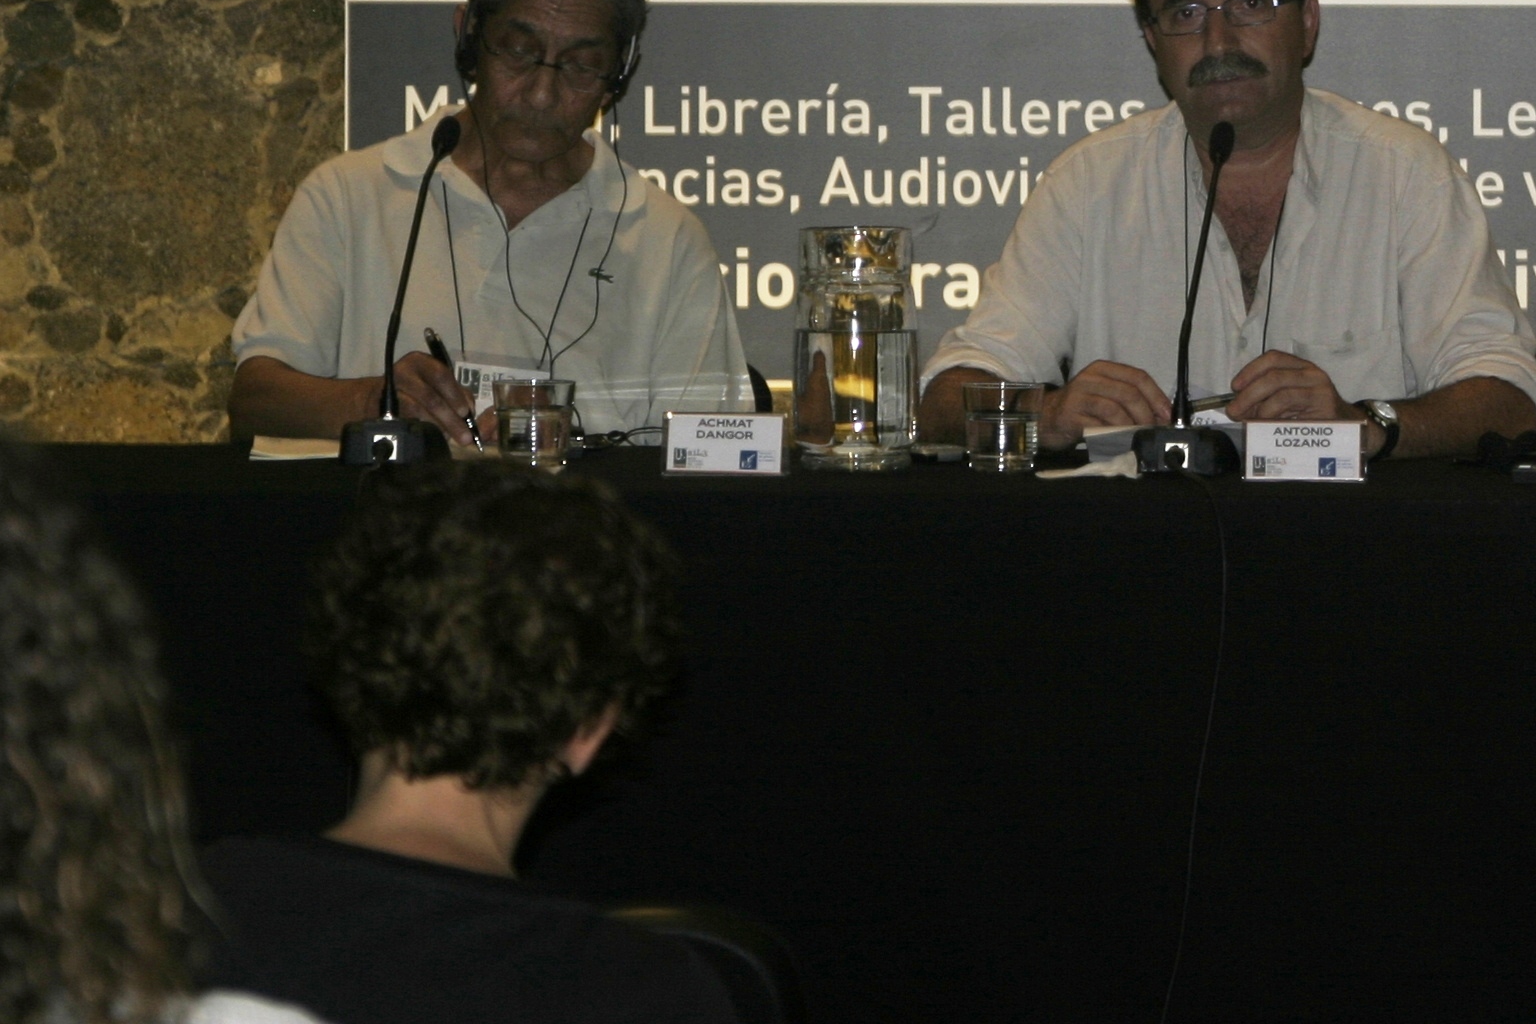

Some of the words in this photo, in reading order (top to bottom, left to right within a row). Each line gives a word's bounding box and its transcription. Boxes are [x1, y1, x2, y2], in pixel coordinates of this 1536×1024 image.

[644, 85, 888, 145] Librería,
[819, 155, 1044, 207] Audiovi
[697, 418, 754, 428] ACHMAT
[696, 430, 754, 440] DANGOR
[1273, 426, 1334, 436] ANTONIO
[1275, 438, 1331, 448] LOZANO
